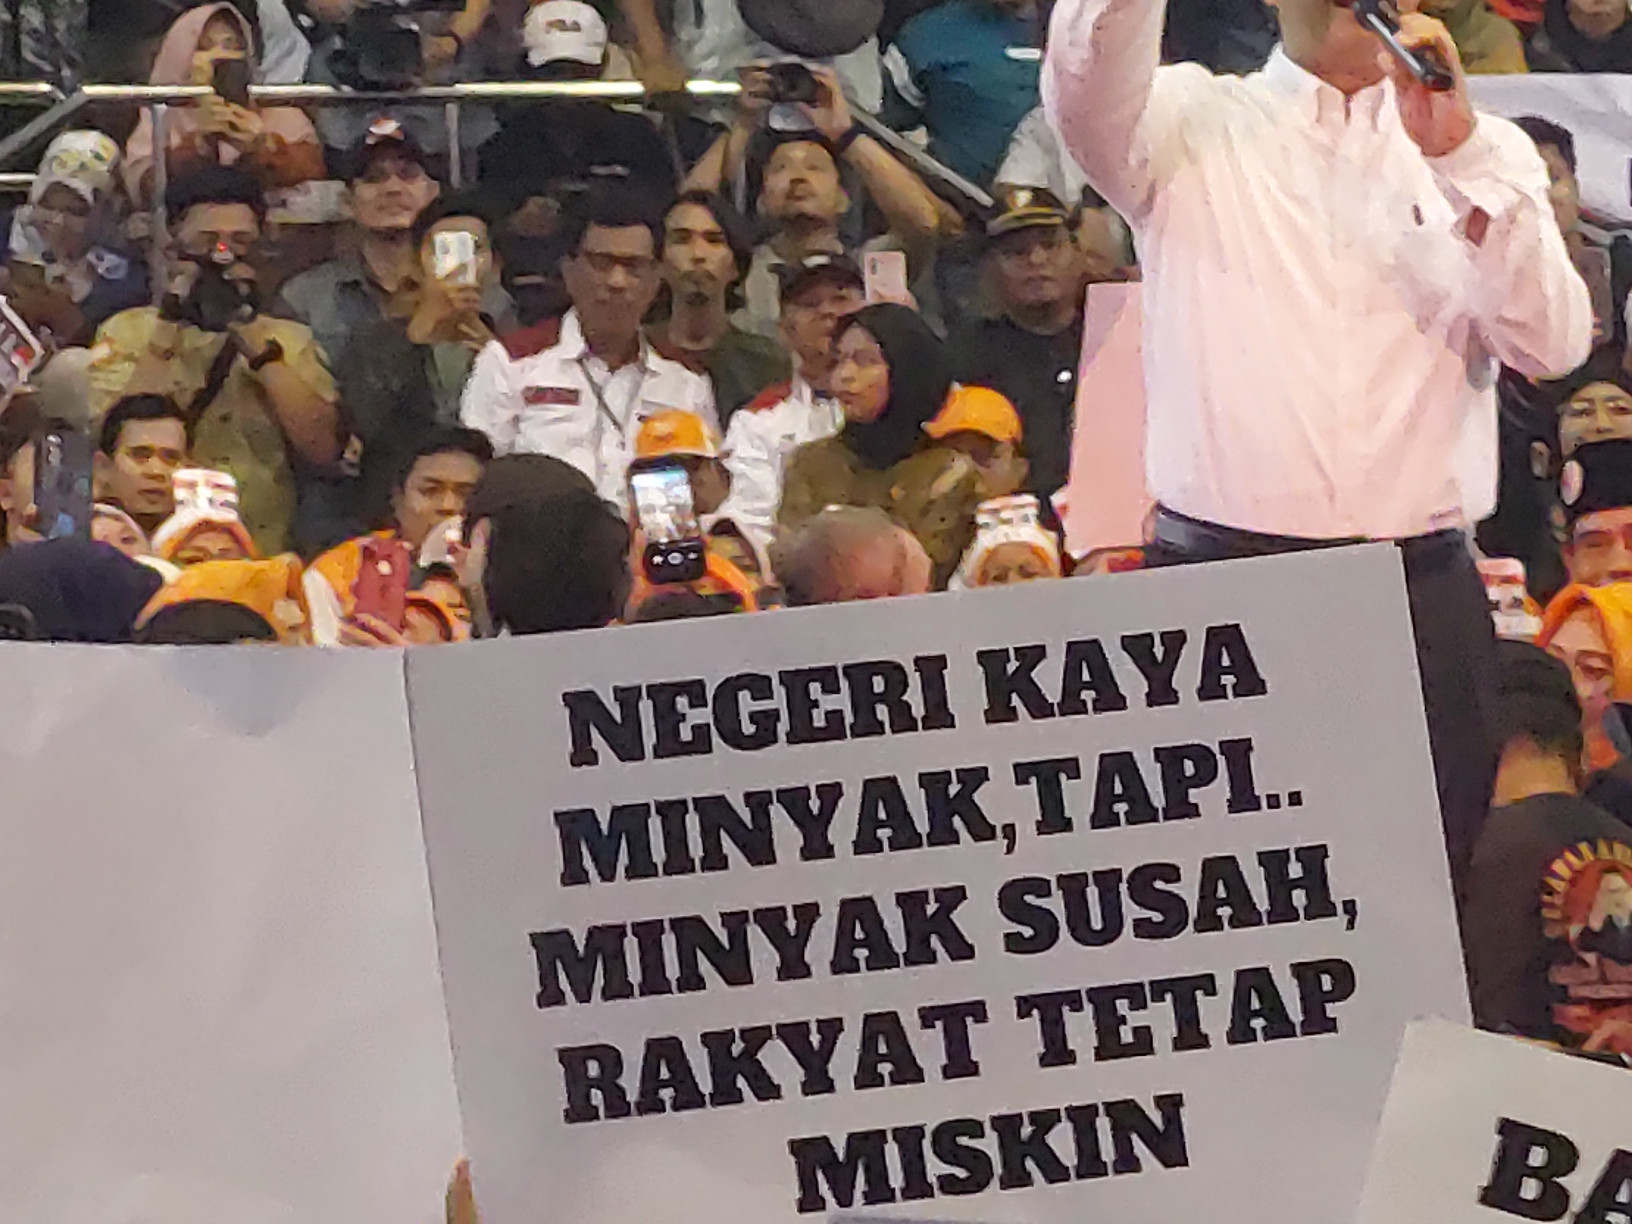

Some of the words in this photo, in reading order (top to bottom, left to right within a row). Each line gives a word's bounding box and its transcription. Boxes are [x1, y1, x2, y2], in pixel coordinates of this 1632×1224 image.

[561, 653, 956, 767] NEGERI
[975, 621, 1268, 725] KAYA
[528, 885, 976, 1010] MINYAK
[997, 843, 1358, 956] SUSAH,
[556, 999, 990, 1125] RAKYAT
[1015, 957, 1357, 1068] TETAP
[786, 1092, 1190, 1214] MISKIN
